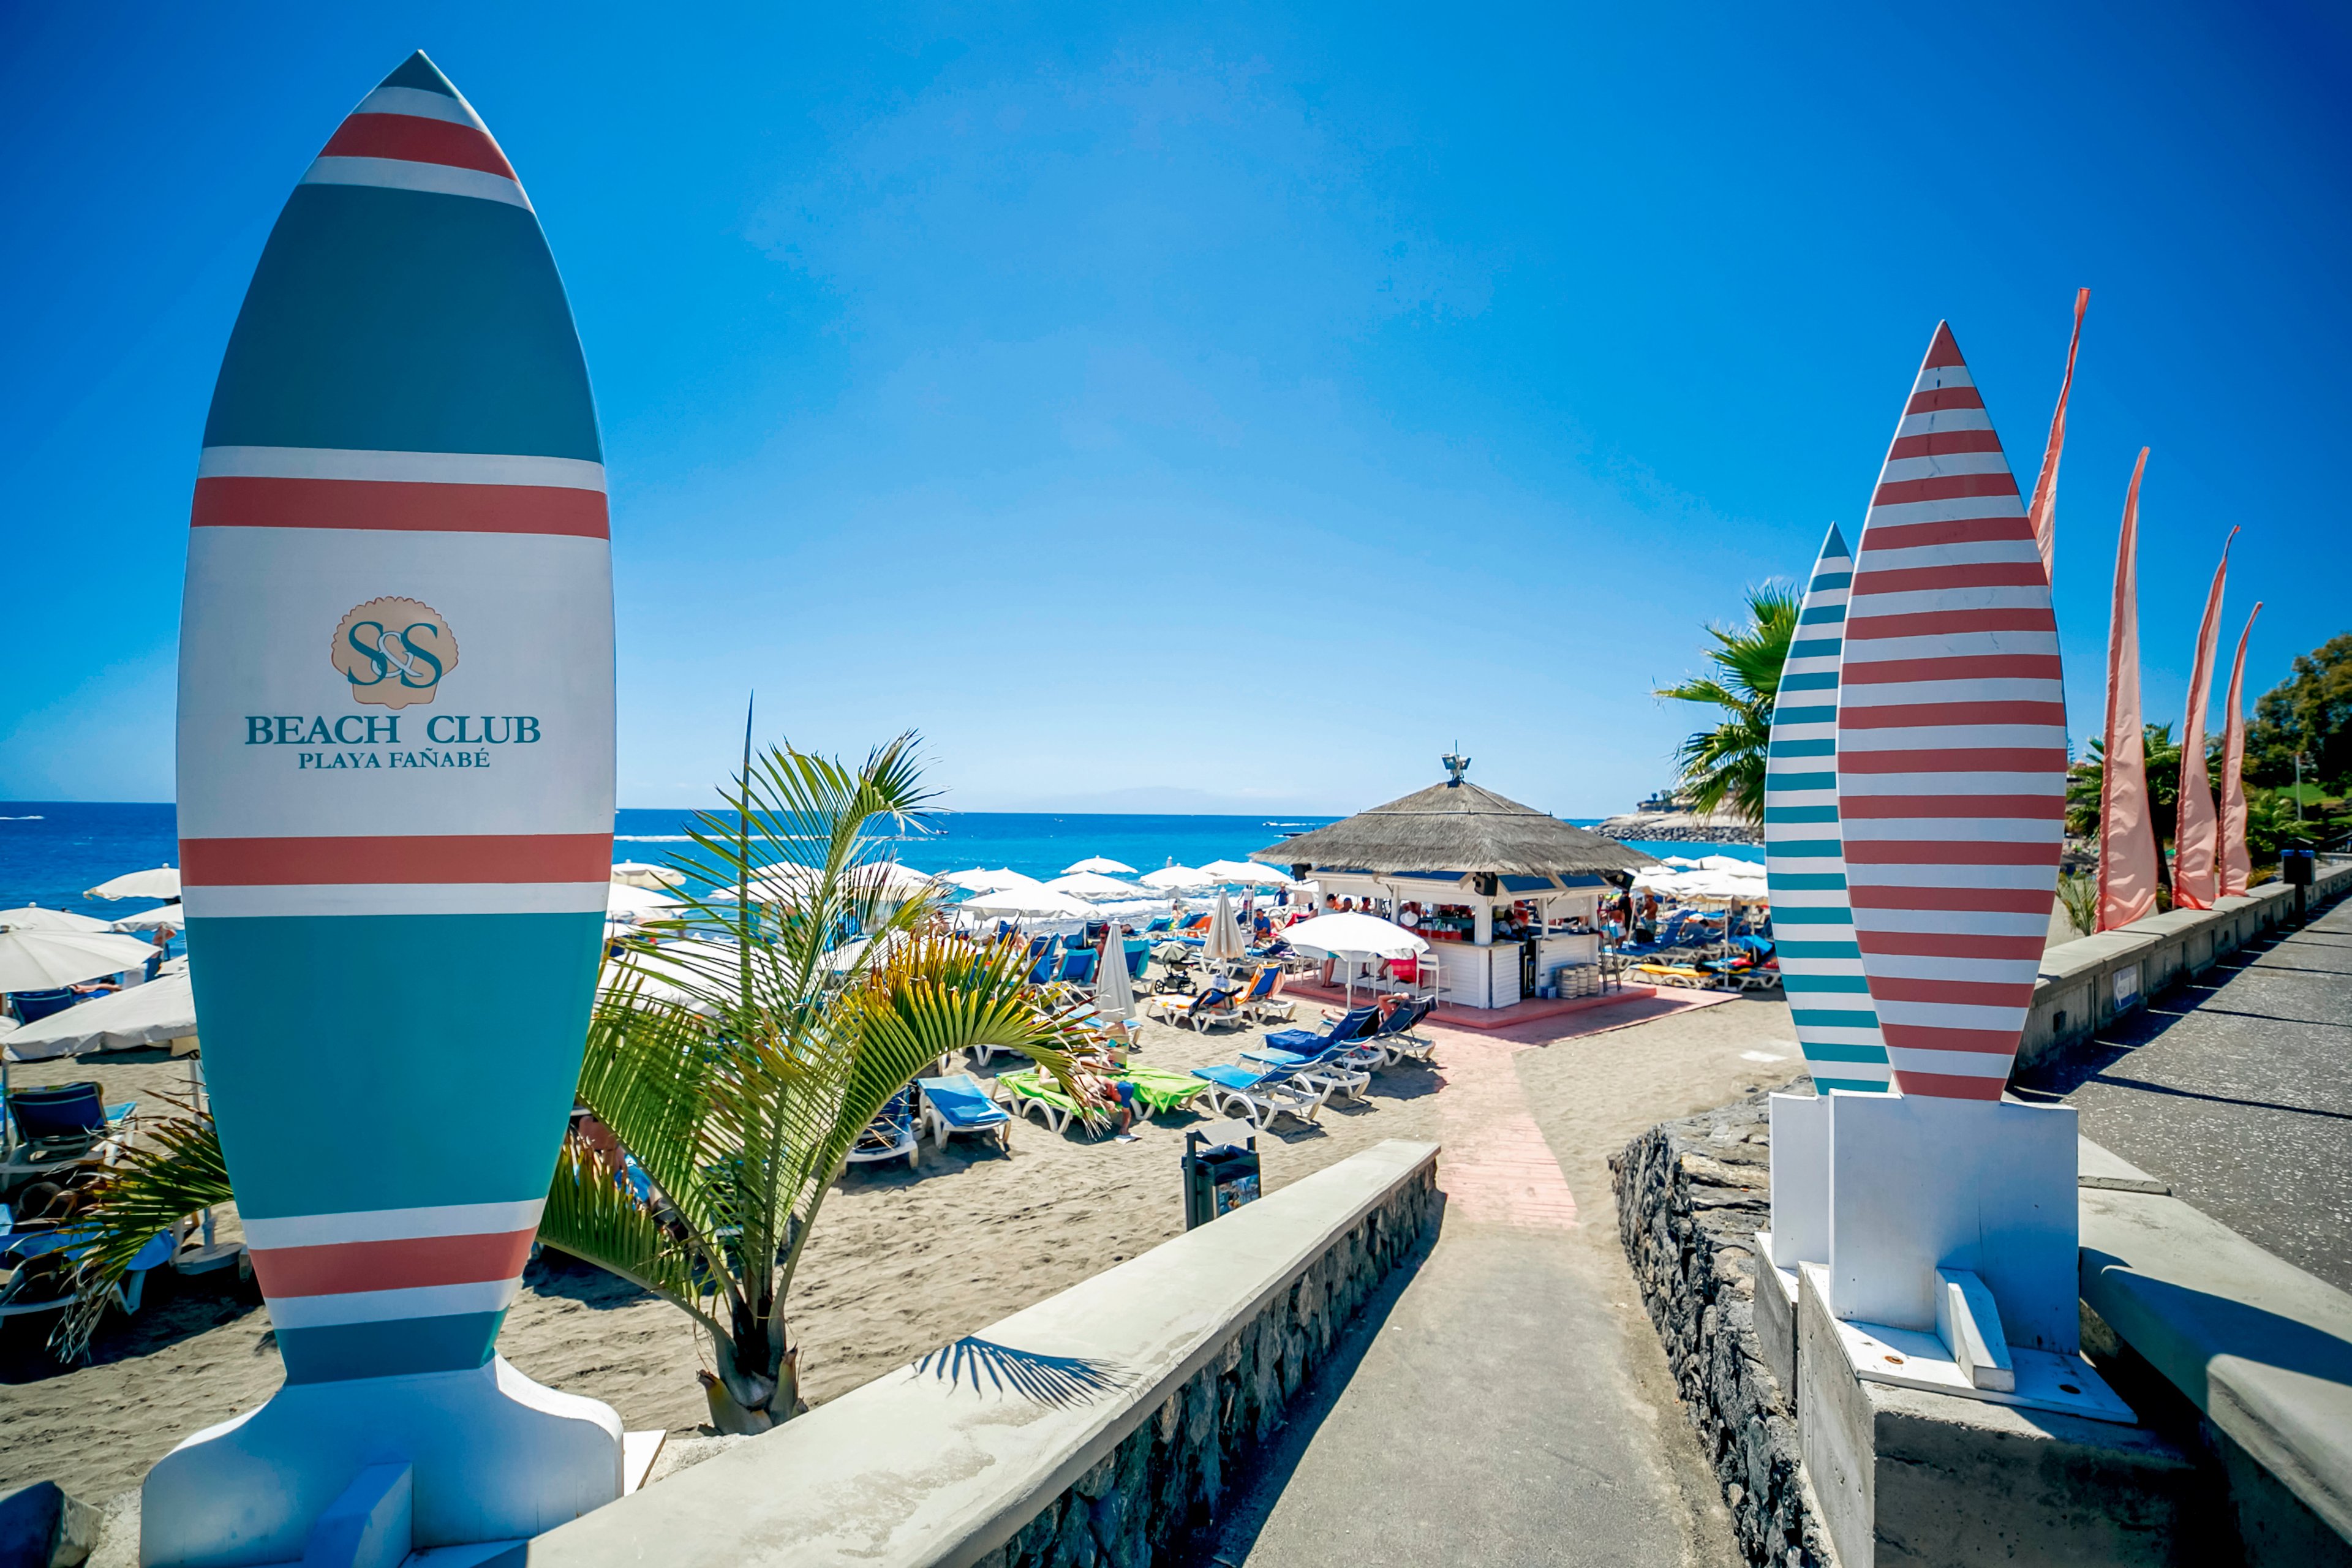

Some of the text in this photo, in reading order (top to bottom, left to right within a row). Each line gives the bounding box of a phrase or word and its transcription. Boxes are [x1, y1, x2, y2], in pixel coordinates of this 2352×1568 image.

[244, 715, 541, 745] BEACH CLUB
[298, 747, 491, 769] PLAYA FAÑABÉ
